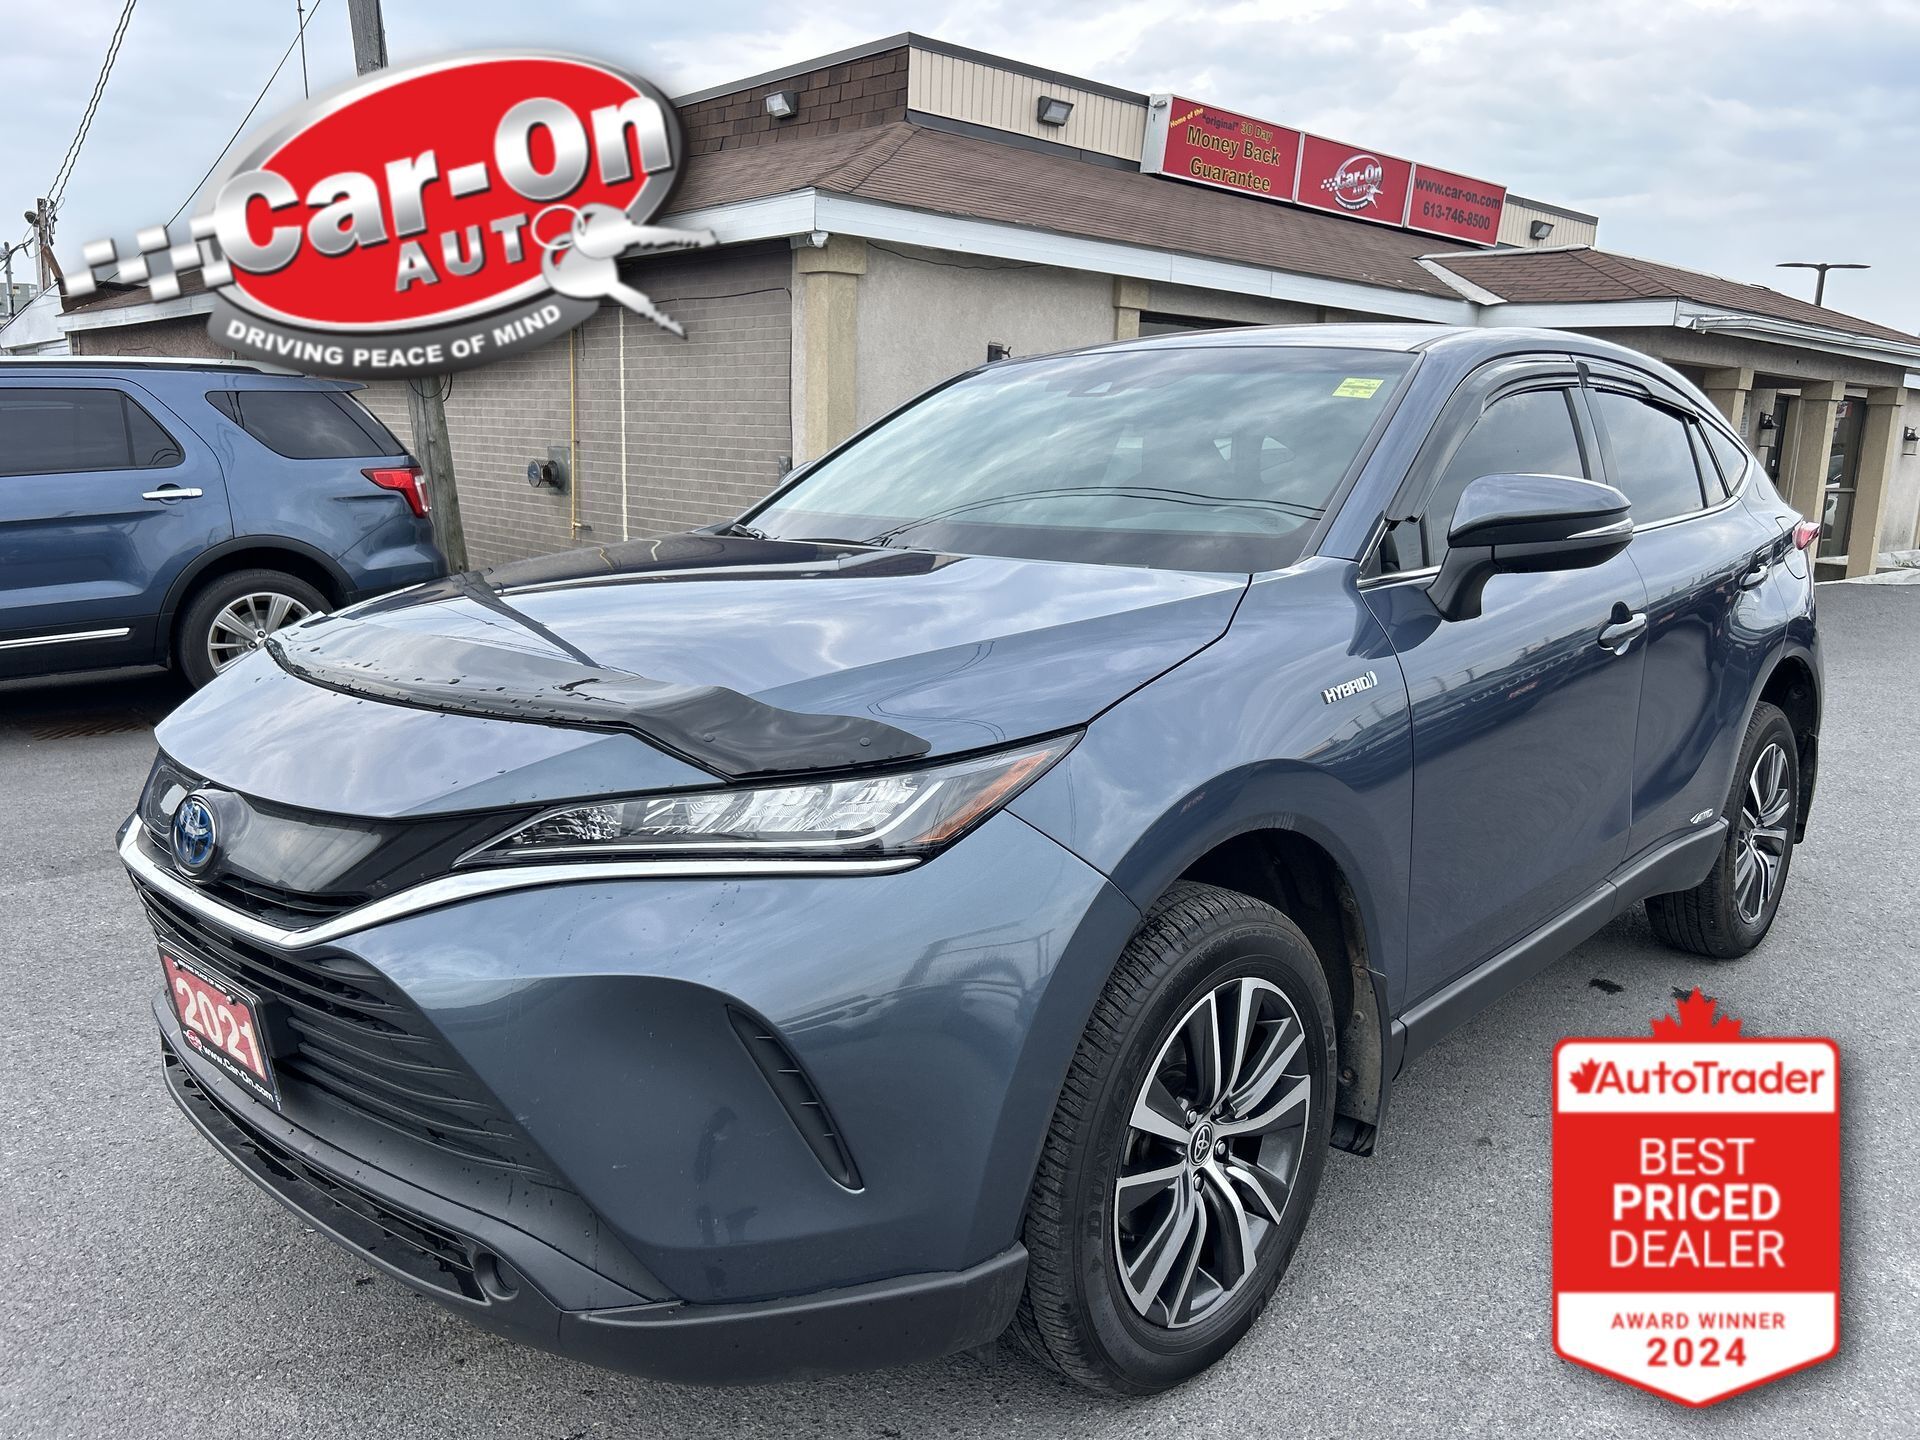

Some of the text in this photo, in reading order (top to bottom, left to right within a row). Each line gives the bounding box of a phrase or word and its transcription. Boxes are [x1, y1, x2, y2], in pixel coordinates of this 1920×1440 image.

[1187, 125, 1281, 167] Money Back
[1241, 121, 1253, 136] 30
[1255, 126, 1273, 143] Day
[1189, 156, 1272, 192] Guarantee
[1336, 164, 1382, 190] Car-On
[1415, 178, 1501, 210] www.car-on.com
[1423, 201, 1491, 230] 613-746-8500
[1321, 675, 1374, 704] HYBRID
[175, 976, 266, 1080] 2021
